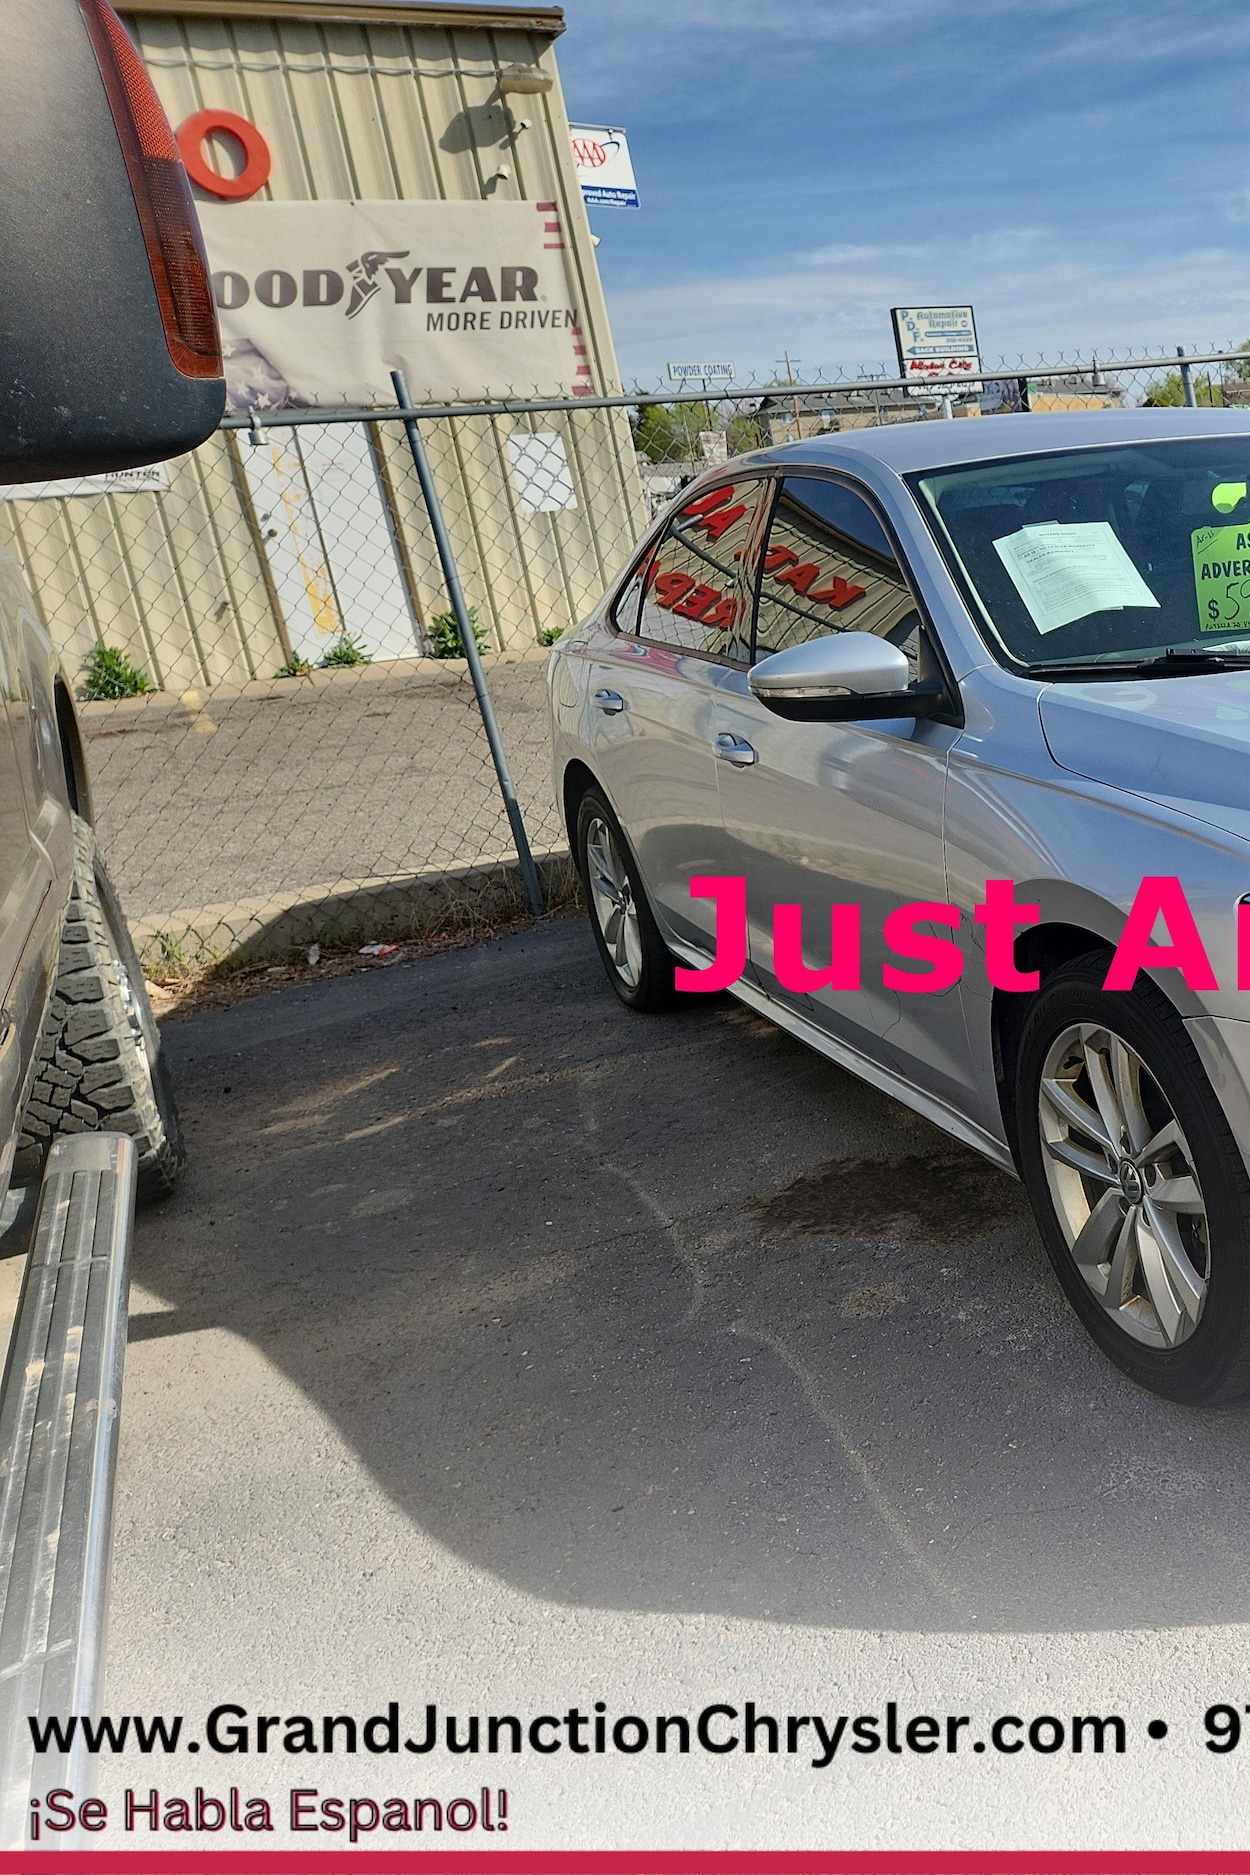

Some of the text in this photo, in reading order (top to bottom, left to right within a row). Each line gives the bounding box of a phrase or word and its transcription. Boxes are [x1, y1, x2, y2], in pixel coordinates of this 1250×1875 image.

[211, 265, 539, 309] OODYEAR
[426, 309, 578, 332] MORE DRIVEN
[916, 310, 968, 320] Automotive
[928, 320, 958, 329] Repair
[672, 364, 733, 377] POWDER COATING
